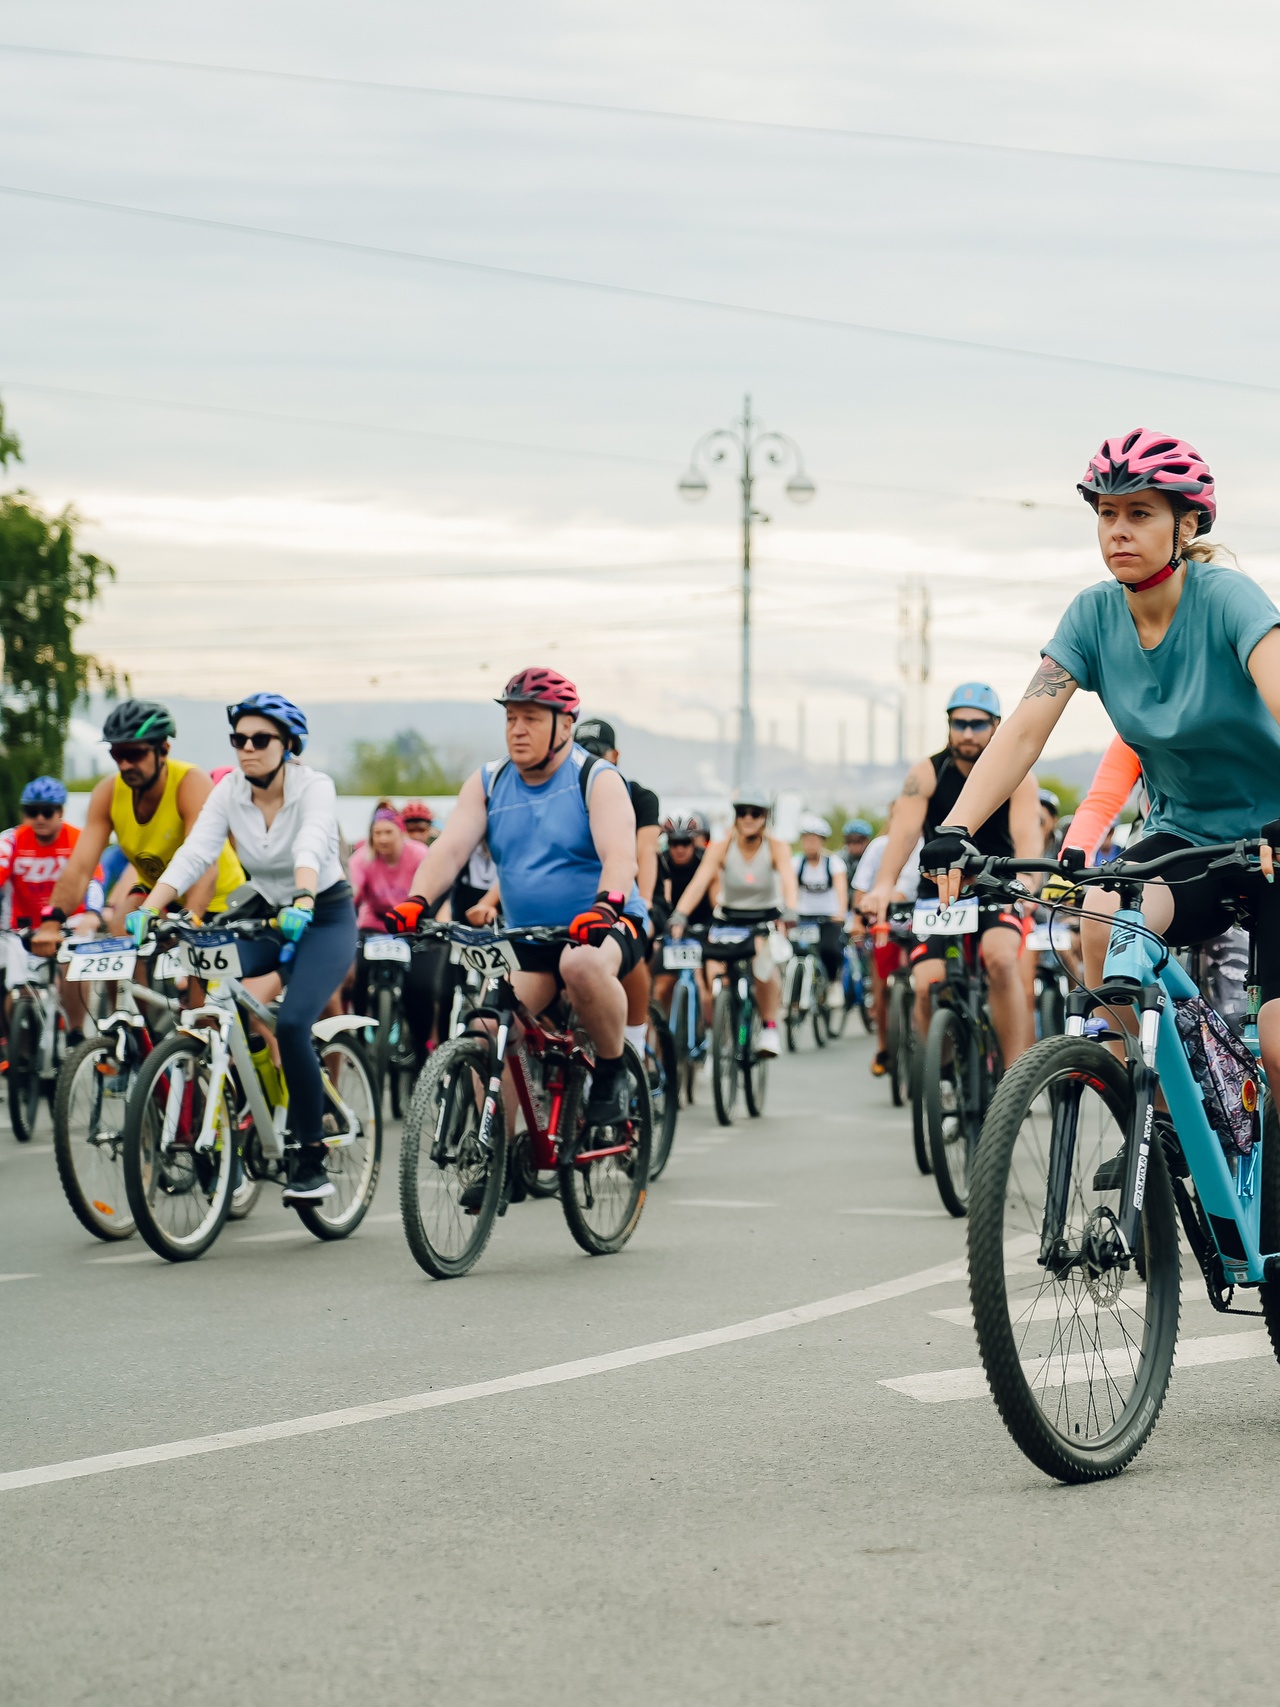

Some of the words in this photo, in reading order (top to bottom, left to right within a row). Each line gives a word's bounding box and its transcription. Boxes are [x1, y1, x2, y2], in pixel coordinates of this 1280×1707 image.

[925, 910, 967, 927] 097
[81, 957, 125, 973] 286
[188, 947, 228, 970] 066
[1142, 1104, 1154, 1141] XCM30
